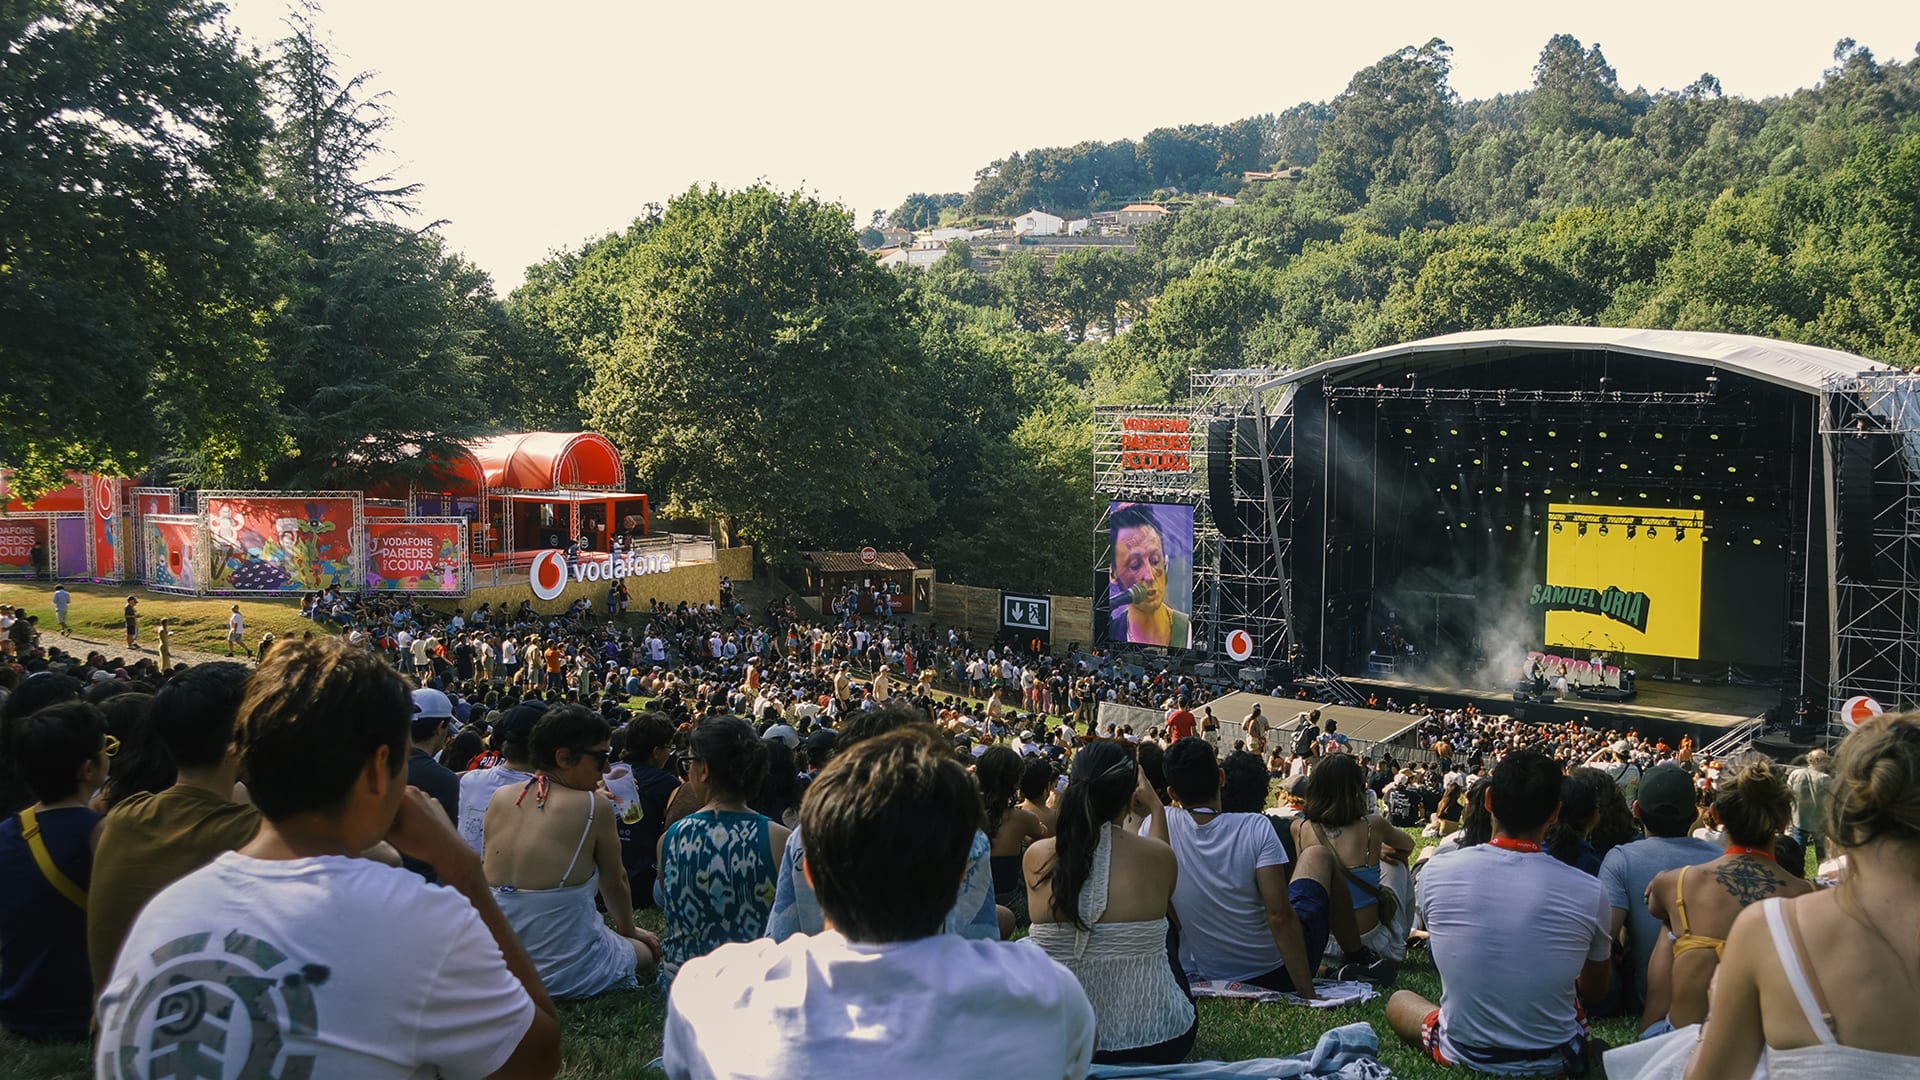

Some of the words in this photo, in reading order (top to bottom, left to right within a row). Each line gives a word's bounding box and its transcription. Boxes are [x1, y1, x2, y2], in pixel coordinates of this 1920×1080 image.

[1121, 433, 1190, 451] PAREDES
[1129, 452, 1190, 472] COURA
[382, 537, 433, 547] VODAFONE
[382, 547, 434, 559] PAREDES
[388, 559, 434, 571] COURA
[572, 550, 671, 582] vodafone
[1529, 584, 1597, 609] SAMUEL
[1599, 587, 1645, 627] ÚRIA
